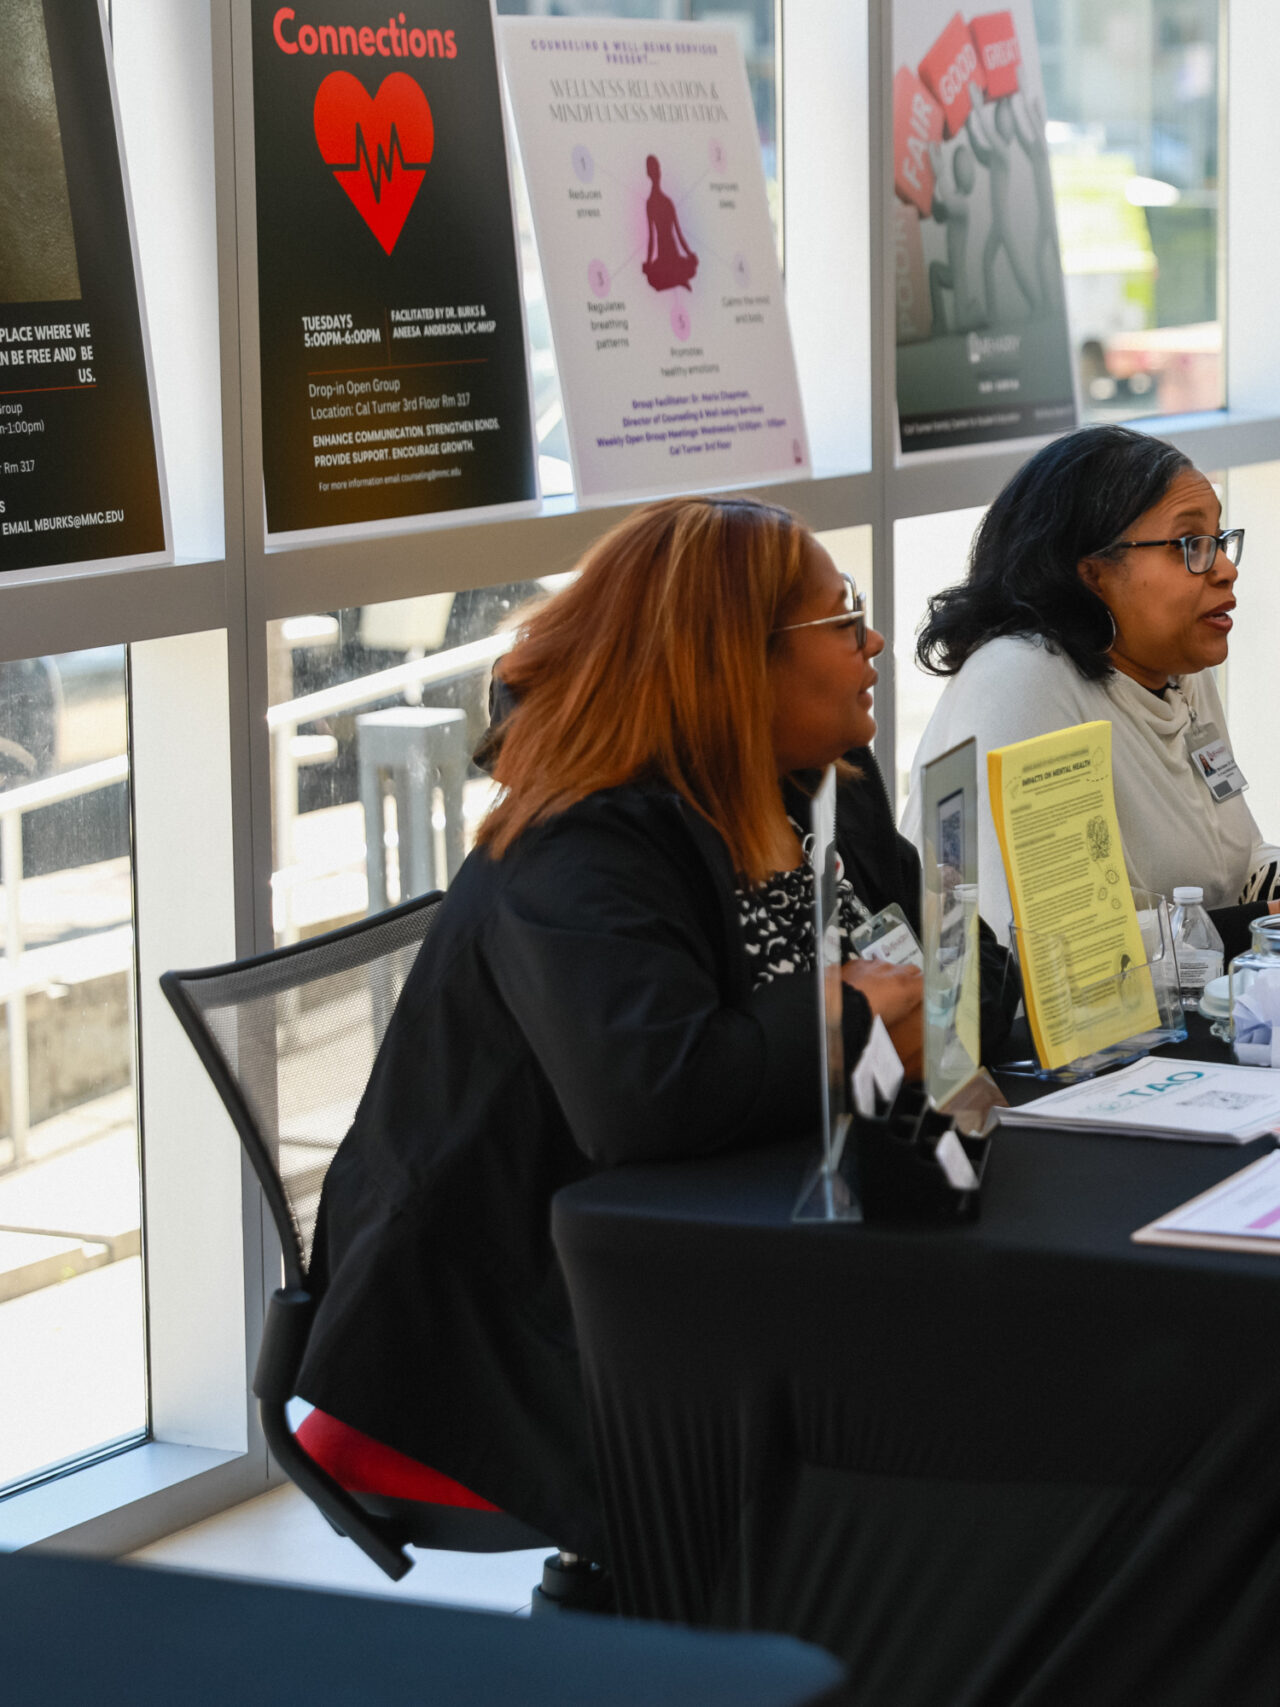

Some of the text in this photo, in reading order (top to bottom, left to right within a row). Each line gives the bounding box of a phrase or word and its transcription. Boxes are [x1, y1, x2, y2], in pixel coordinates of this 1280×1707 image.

[272, 7, 458, 59] Connections
[982, 37, 1022, 71] GREAT
[938, 42, 978, 106] GOOD
[550, 78, 626, 99] WELLNESS
[627, 79, 708, 99] RELAXATION
[549, 102, 729, 123] MINDFULNESS MEDITATION
[901, 92, 933, 192] FAIR
[301, 313, 354, 331] TUESDAYS
[391, 307, 434, 322] FACILITATED
[434, 306, 445, 320] BY
[444, 305, 457, 319] DR.
[457, 304, 480, 319] BURKS
[0, 322, 92, 343] PLACE WHERE WE
[304, 327, 382, 348] 5:00PM-6:00PM
[392, 325, 422, 340] ANEESA
[423, 322, 463, 337] ANDERSON,
[10, 349, 25, 366] BE
[25, 348, 53, 364] FREE
[53, 345, 77, 363] AND
[80, 345, 94, 361] BE
[78, 367, 97, 383] US.
[308, 377, 401, 399] Drop-in Open Group
[310, 391, 471, 421] Location: Cal Turner 3rd Floor Rm 317
[312, 417, 500, 449] ENHANCE COMMUNICATION. STRENGTHEN BONDS.
[314, 439, 474, 468] PROVIDE SUPPORT. ENCOURAGE GROWTH.
[4, 462, 19, 474] Rm
[20, 459, 35, 473] 317
[319, 481, 330, 492] For
[330, 479, 348, 491] more
[348, 476, 384, 488] information
[2, 510, 124, 536] EMAIL MBURKS@MMC.EDU
